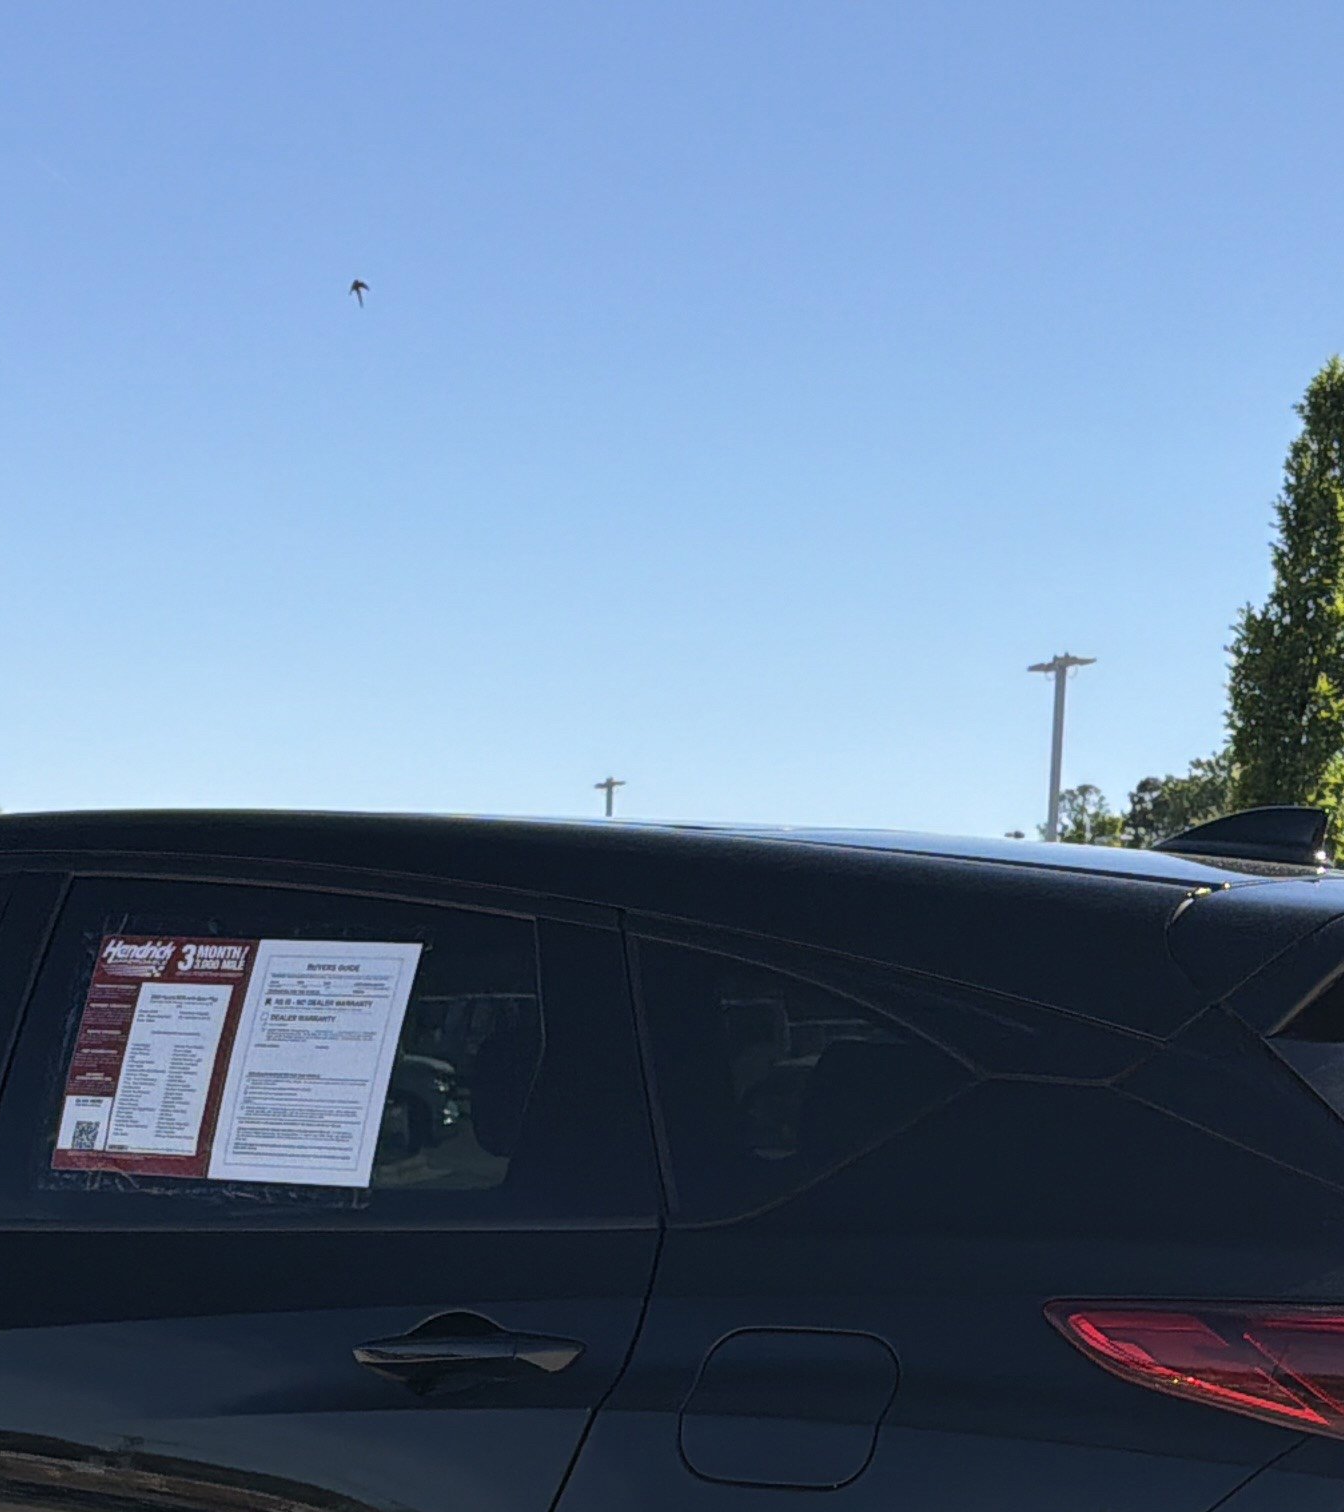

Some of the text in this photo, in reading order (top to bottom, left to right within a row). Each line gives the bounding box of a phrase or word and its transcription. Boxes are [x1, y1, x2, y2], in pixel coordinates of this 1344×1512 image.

[102, 939, 177, 963] Hendrick
[177, 944, 197, 971] 3
[221, 960, 246, 971] MILE
[335, 999, 373, 1008] WARRANTY
[270, 1013, 297, 1021] DEALER
